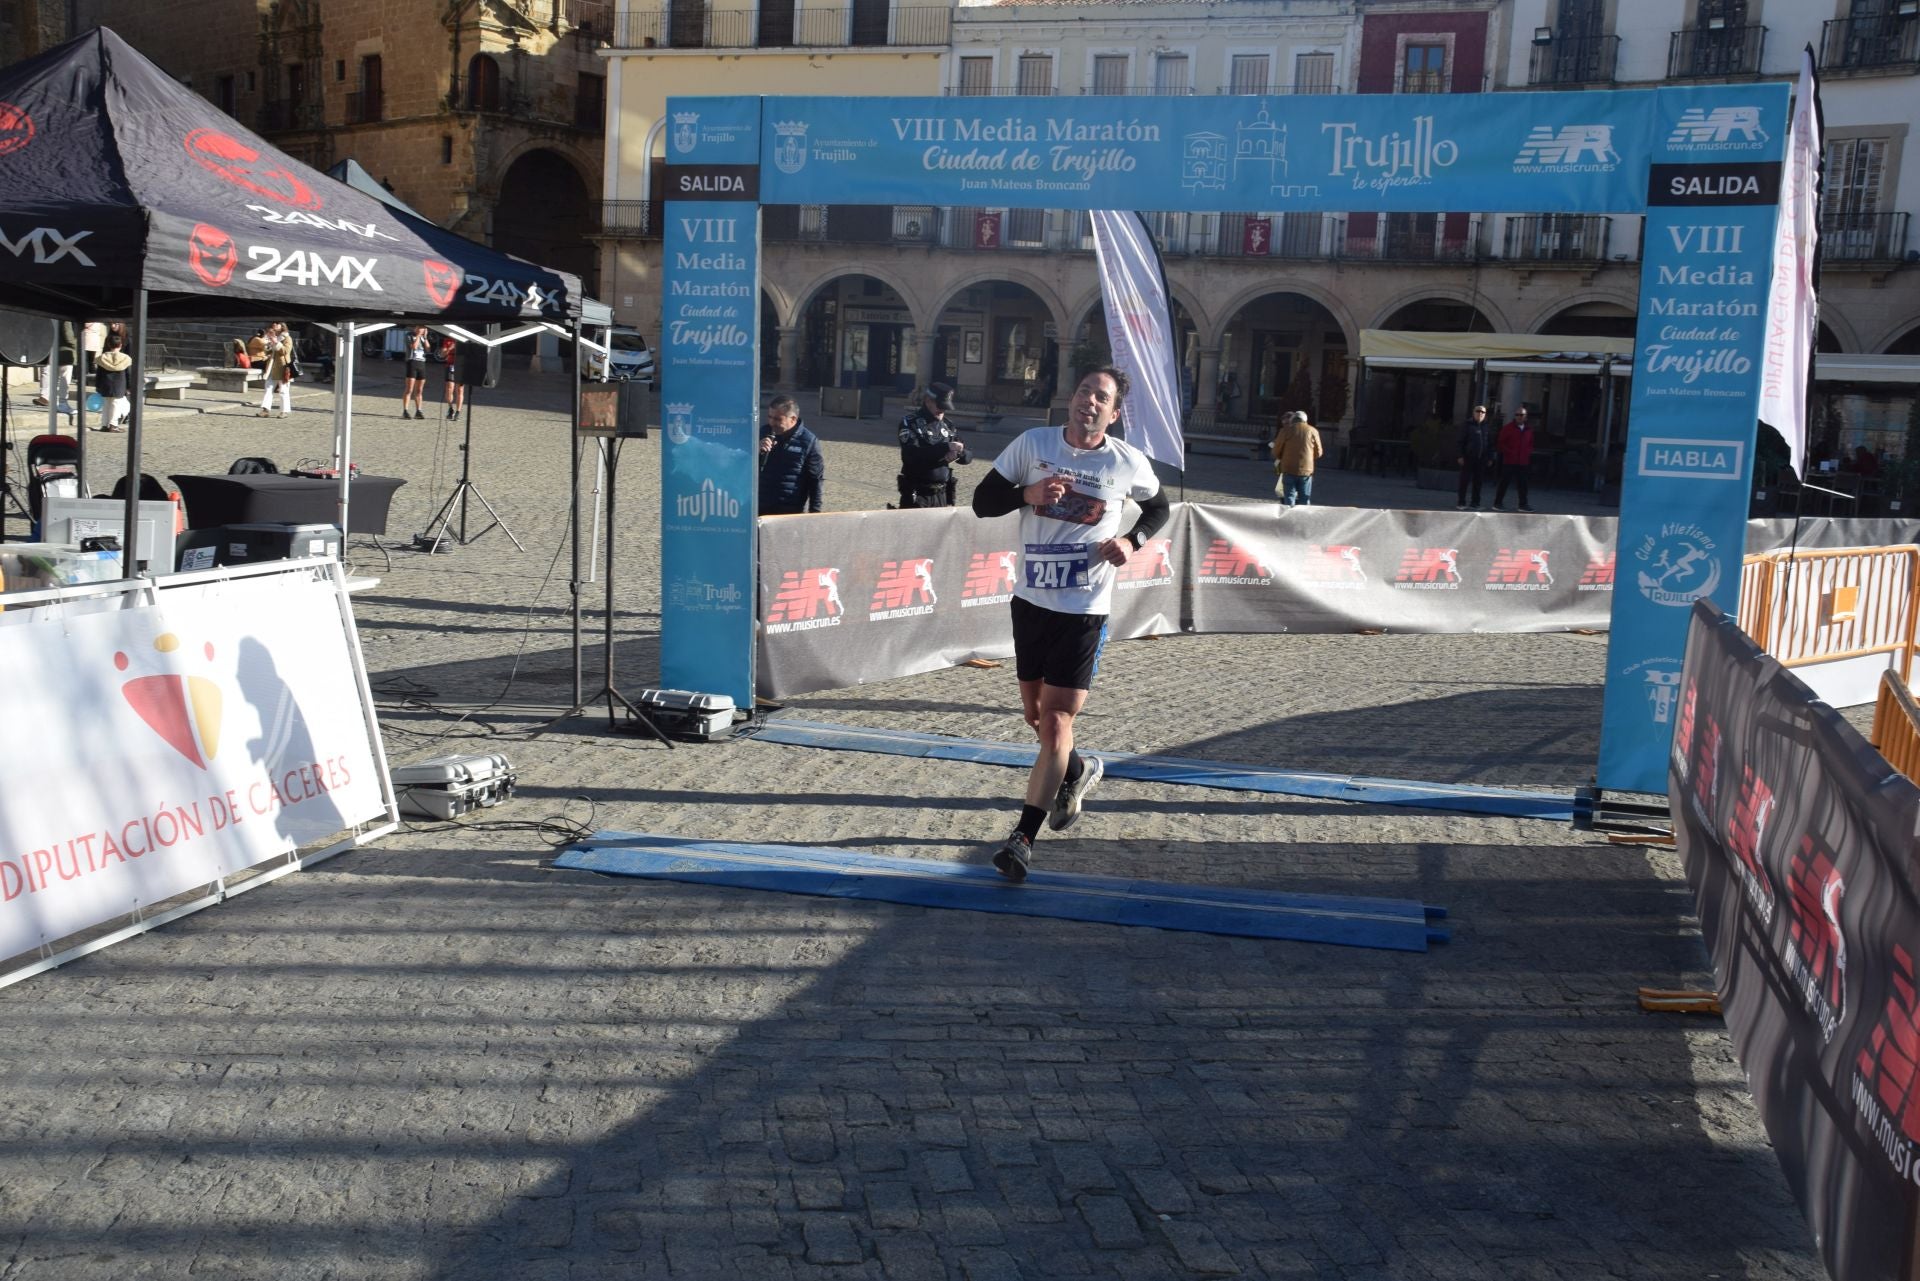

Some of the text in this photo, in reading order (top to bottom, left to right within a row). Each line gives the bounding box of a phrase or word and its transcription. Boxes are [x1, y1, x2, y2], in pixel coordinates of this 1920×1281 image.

[702, 133, 735, 144] Trujillo
[891, 118, 1161, 142] VIII Media Maratón
[814, 139, 878, 148] Ayuntamiento de
[1321, 115, 1458, 178] Trujillo
[1666, 141, 1763, 152] www.musicrun.es
[813, 149, 857, 162] Trujillo
[923, 145, 1136, 181] Ciudad de Trujillo
[1512, 163, 1615, 174] www.musicrun.es
[680, 175, 745, 191] SALIDA
[960, 178, 1091, 191] Juan Mateos Broncano
[1352, 170, 1368, 190] te
[1670, 176, 1760, 196] SALIDA
[680, 218, 736, 243] VIII
[1667, 225, 1744, 254] VIII
[246, 246, 384, 291] 24MX
[676, 252, 746, 270] Media
[1656, 265, 1754, 286] Media
[671, 280, 750, 297] Maratón
[680, 304, 738, 318] Ciudad de
[1648, 297, 1759, 316] Maratón
[669, 320, 748, 354] Trujillo
[1660, 325, 1740, 341] Ciudad de
[1644, 344, 1752, 384] Trujillo
[1646, 386, 1746, 398] Juan Mateos Broncano
[696, 424, 732, 437] Trujillo
[1654, 450, 1727, 468] HABLA
[1635, 522, 1717, 561] Club Atletismo
[1033, 561, 1071, 588] 247
[1117, 577, 1172, 590] www.musicrun.es
[1198, 575, 1271, 586] www.musicrun.es
[1394, 581, 1458, 591] www.musicrun.es
[1485, 583, 1549, 591] www.musicrun.es
[869, 603, 934, 622] www.musicrun.es
[766, 616, 841, 635] www.musicrun.es
[0, 755, 351, 903] DIPUTACIÓN DE CÁCERES
